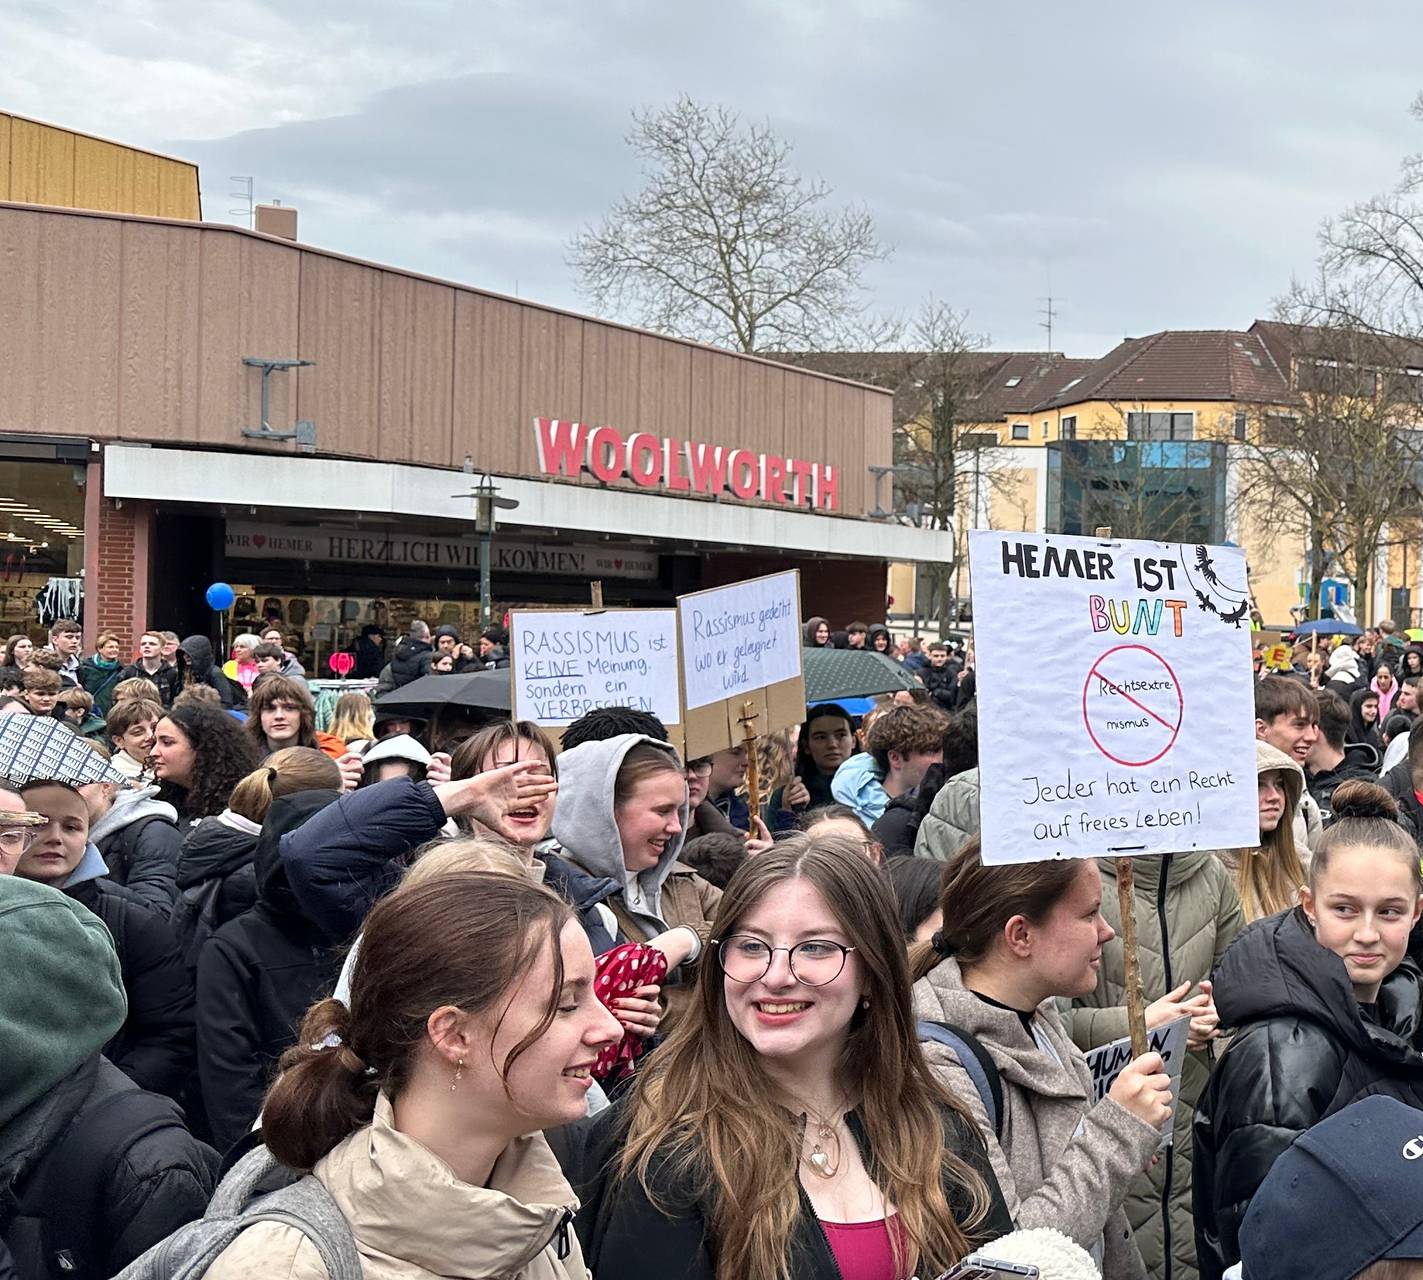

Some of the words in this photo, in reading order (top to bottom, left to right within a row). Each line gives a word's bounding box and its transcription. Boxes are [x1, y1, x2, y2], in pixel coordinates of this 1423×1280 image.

[533, 416, 839, 511] WOOLWORTH
[269, 537, 313, 552] HEMER
[328, 536, 440, 563] HERZLICH
[446, 544, 585, 572] WILKOMMEN!
[1001, 540, 1115, 580] HEMER
[1133, 558, 1177, 592] IST
[693, 609, 756, 642] Rassismus
[1089, 594, 1187, 637] BUNT
[522, 629, 640, 656] RASSISMUS
[648, 633, 668, 652] ist
[716, 648, 728, 666] er
[525, 659, 579, 679] KEINE
[525, 680, 587, 699] sondern
[605, 680, 627, 693] ein
[1099, 679, 1174, 696] Rechtsextre-
[1106, 717, 1149, 731] mismus
[1022, 768, 1097, 805] Jeder
[1106, 772, 1140, 796] hat
[1150, 776, 1182, 794] ein
[1188, 770, 1236, 790] Recht
[1033, 814, 1072, 840] auf
[1078, 811, 1129, 834] freies
[1135, 801, 1202, 829] Leben!
[1086, 1028, 1171, 1081] HUMN
